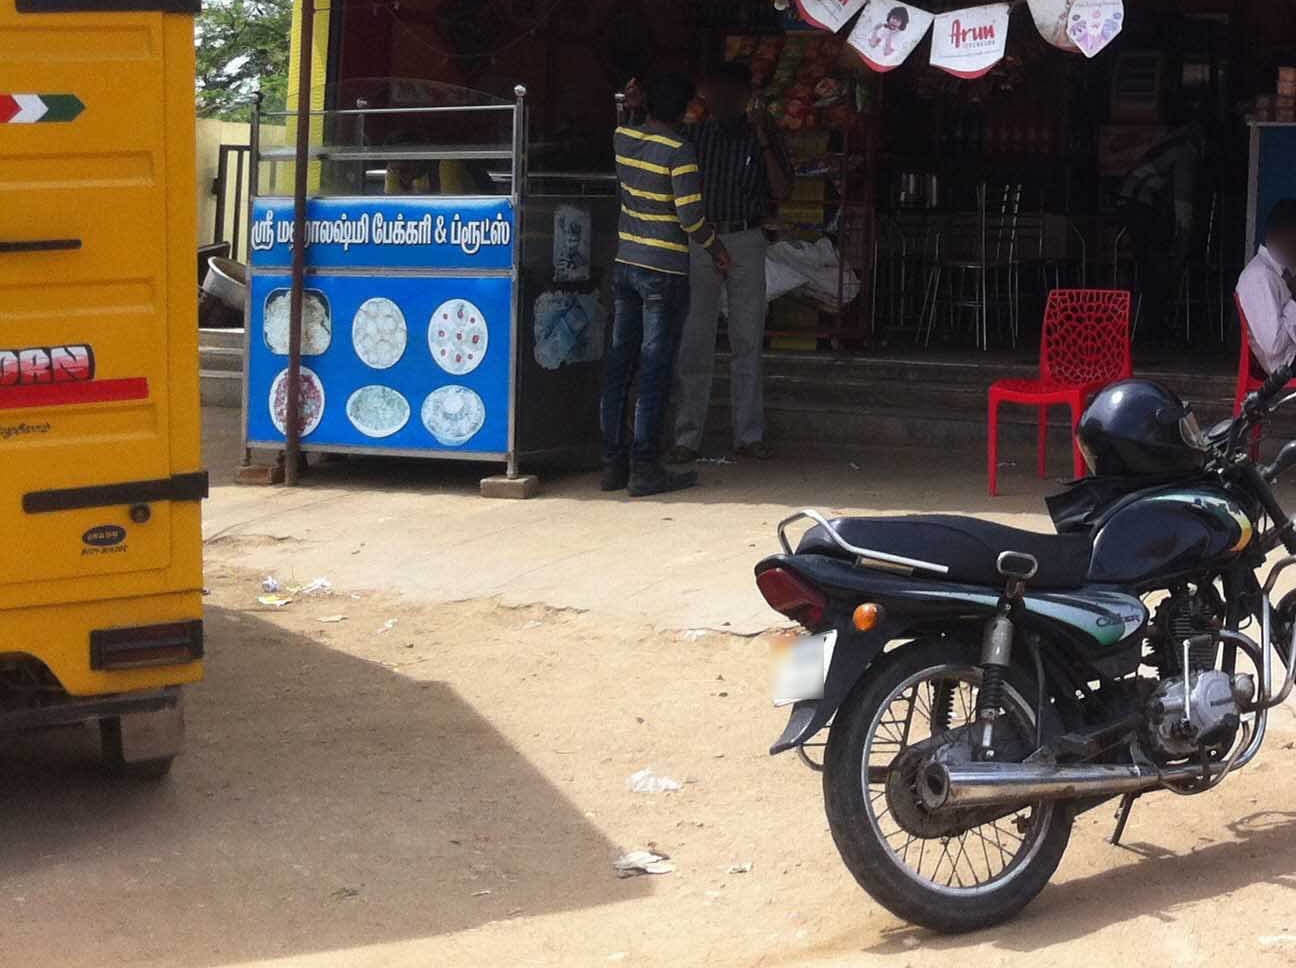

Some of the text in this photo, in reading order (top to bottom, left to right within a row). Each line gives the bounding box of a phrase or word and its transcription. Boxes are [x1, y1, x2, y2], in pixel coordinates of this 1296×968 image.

[950, 18, 995, 49] Arun
[277, 213, 369, 251] மாலஷ்மி
[371, 211, 432, 246] பேக்கரி
[434, 214, 448, 245] &
